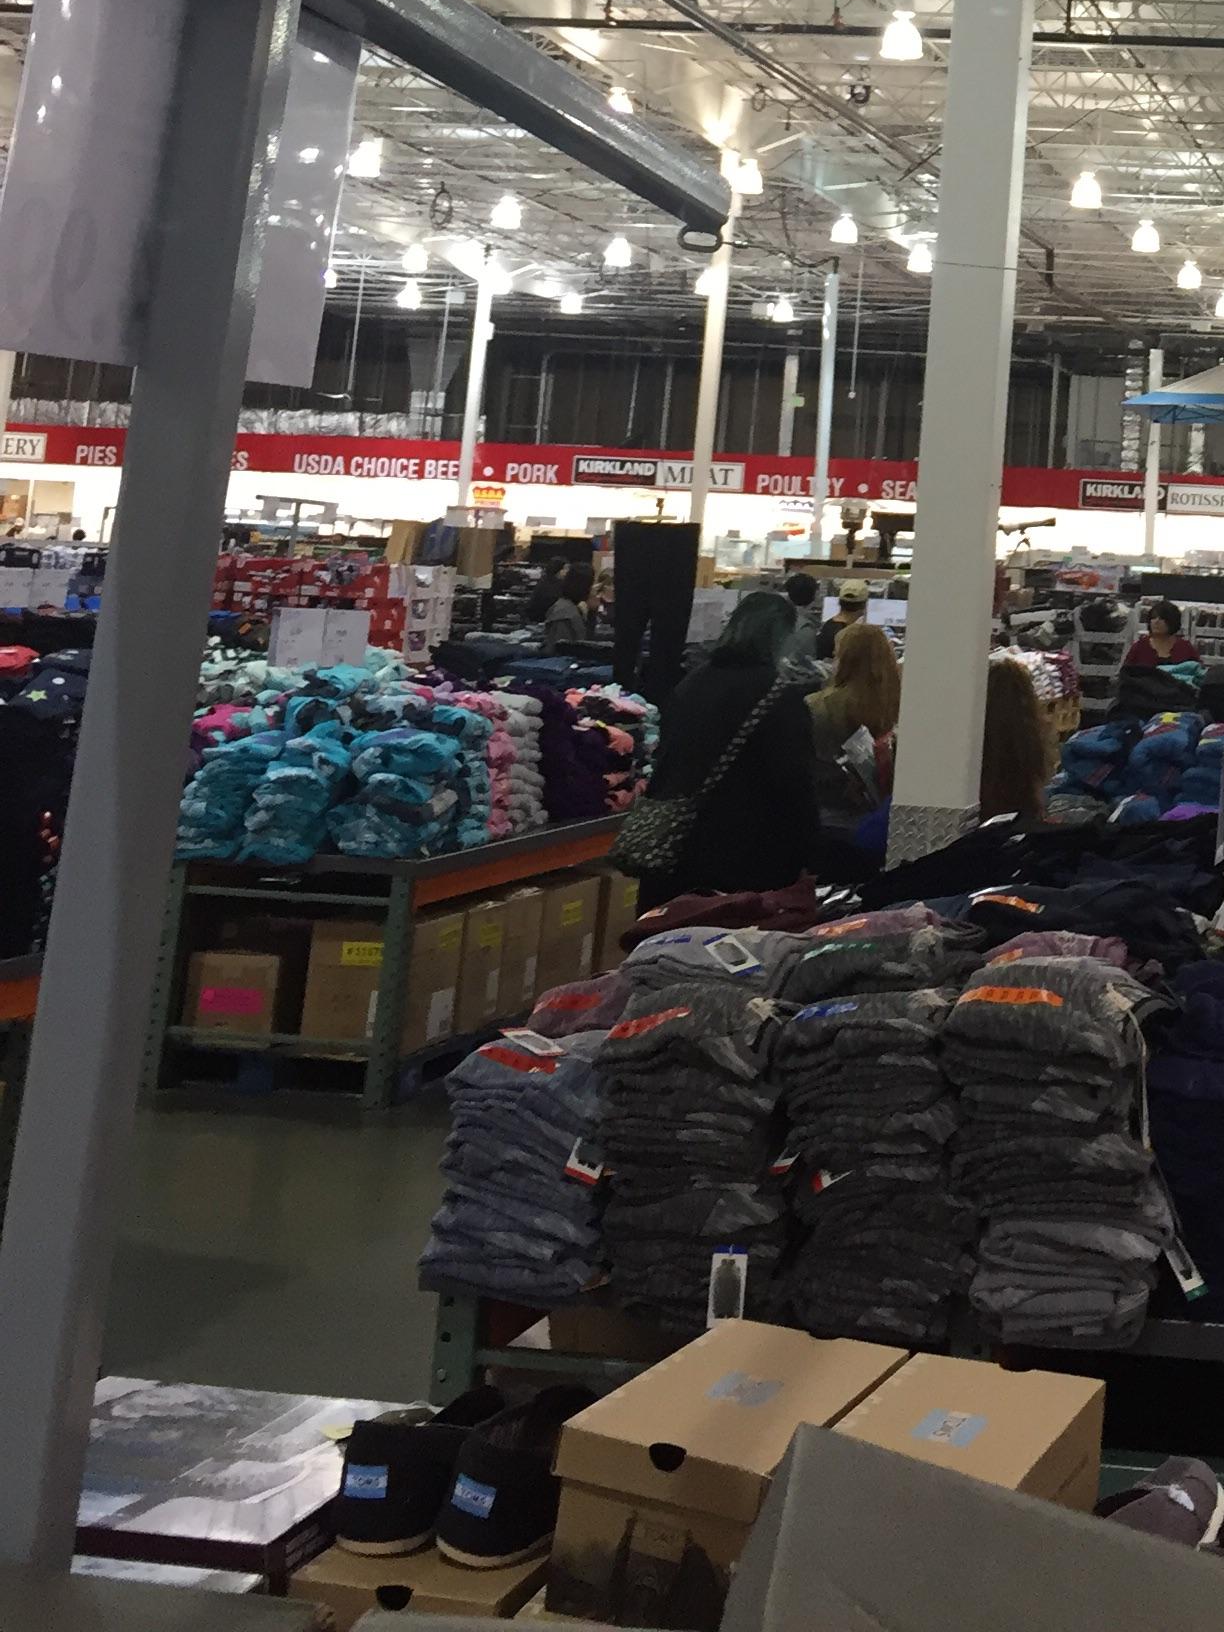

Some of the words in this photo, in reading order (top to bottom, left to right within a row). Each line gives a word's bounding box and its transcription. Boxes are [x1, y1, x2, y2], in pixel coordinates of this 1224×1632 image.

[75, 445, 118, 466] PIES
[294, 454, 345, 476] USDA
[350, 456, 419, 480] CHOICE
[424, 459, 460, 480] BEE
[505, 463, 559, 484] PORK
[578, 459, 656, 476] KIRKLAND
[665, 464, 735, 486] MAT
[1085, 483, 1166, 500] KIRKLAD
